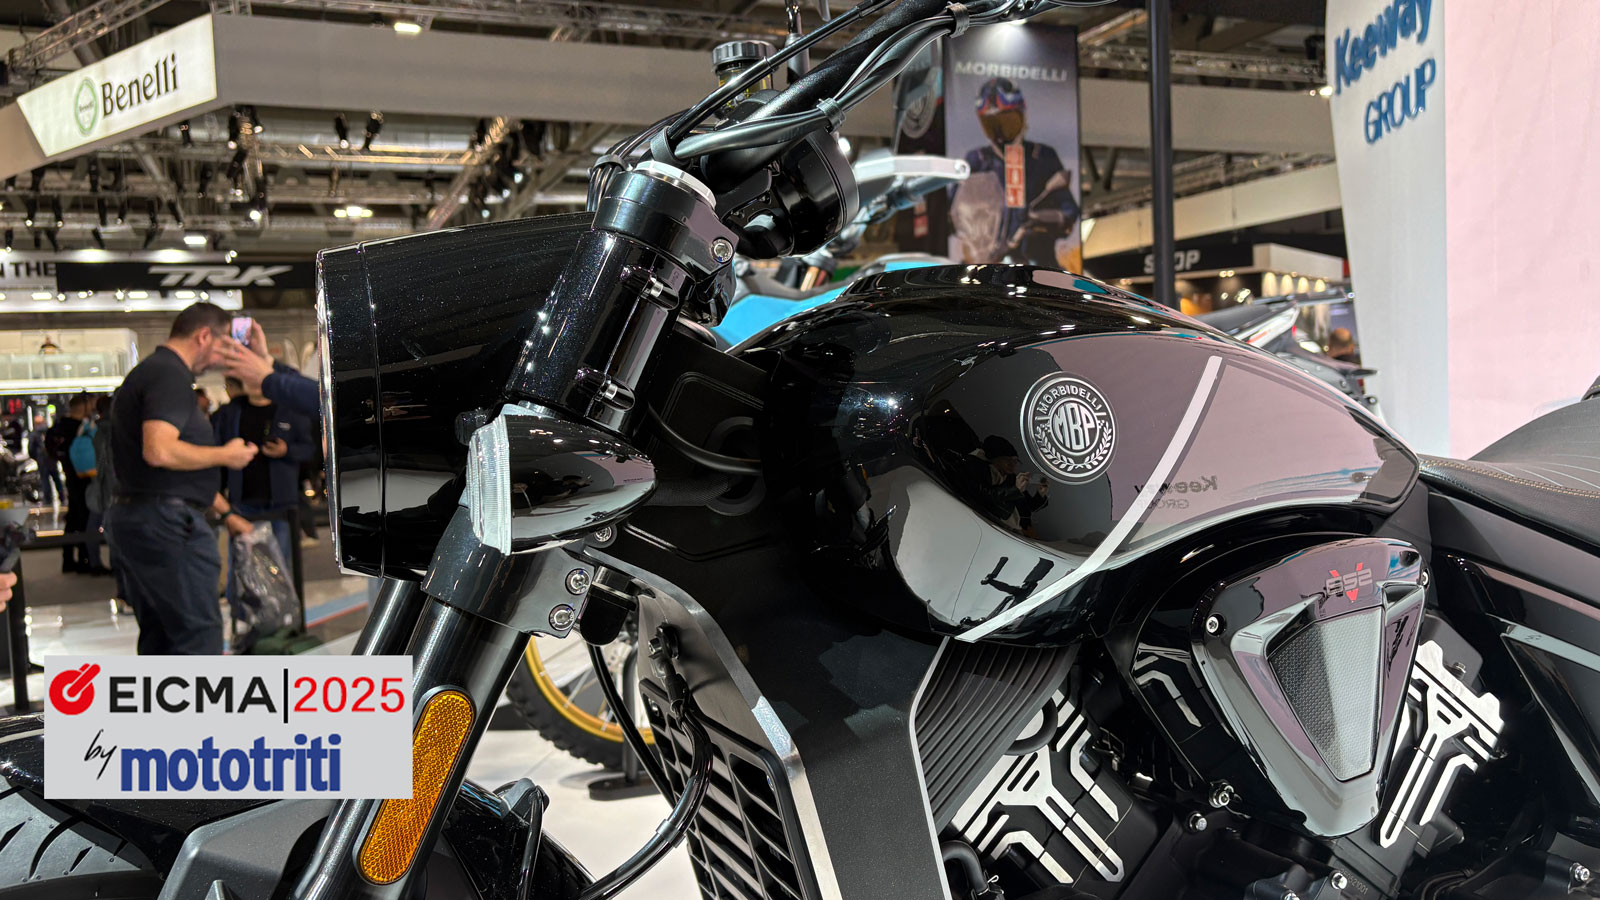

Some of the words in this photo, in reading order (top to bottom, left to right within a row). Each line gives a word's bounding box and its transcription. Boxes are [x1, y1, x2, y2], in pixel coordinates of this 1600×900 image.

[102, 52, 179, 118] Benelli
[955, 61, 1068, 82] MORBIDELLI
[1364, 57, 1436, 145] GROUP
[9, 261, 57, 277] THE
[148, 265, 294, 286] TRK
[1144, 249, 1200, 274] SOP
[1036, 384, 1102, 415] MORBIDELLI
[1052, 402, 1096, 450] MBP
